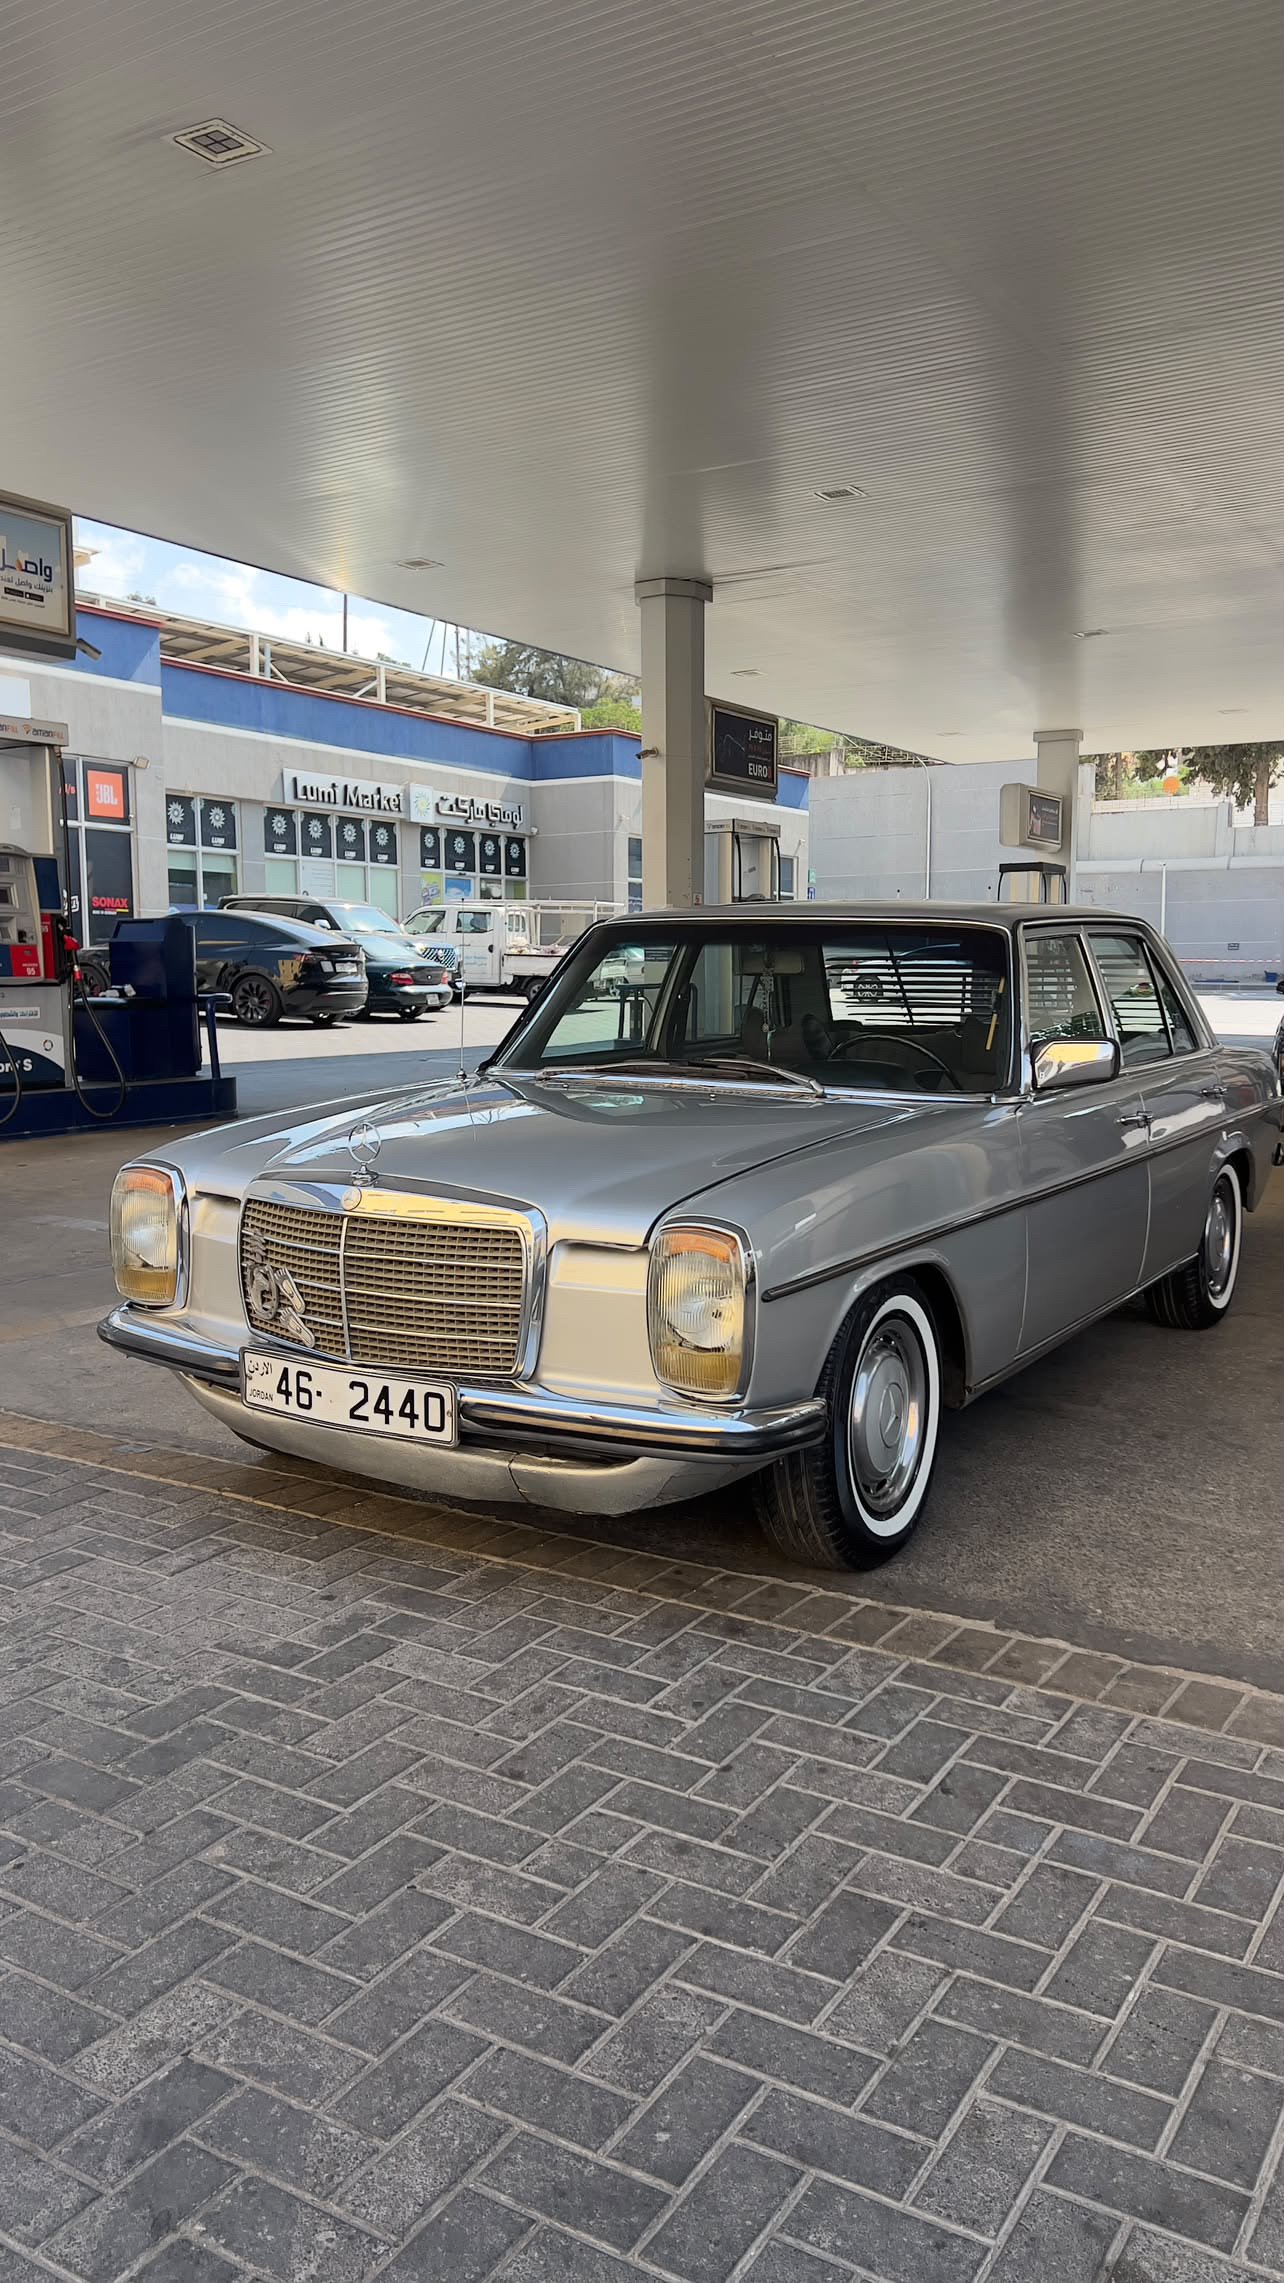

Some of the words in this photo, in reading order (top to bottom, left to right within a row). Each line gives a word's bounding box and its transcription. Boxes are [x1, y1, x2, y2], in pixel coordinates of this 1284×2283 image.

[748, 763, 768, 778] EURO
[95, 783, 118, 805] JBL
[293, 776, 339, 805] Lumi
[342, 784, 404, 813] Market
[91, 896, 128, 909] SONAX
[23, 1058, 33, 1072] S
[249, 1388, 274, 1402] JORDAN
[349, 1380, 445, 1433] 2440
